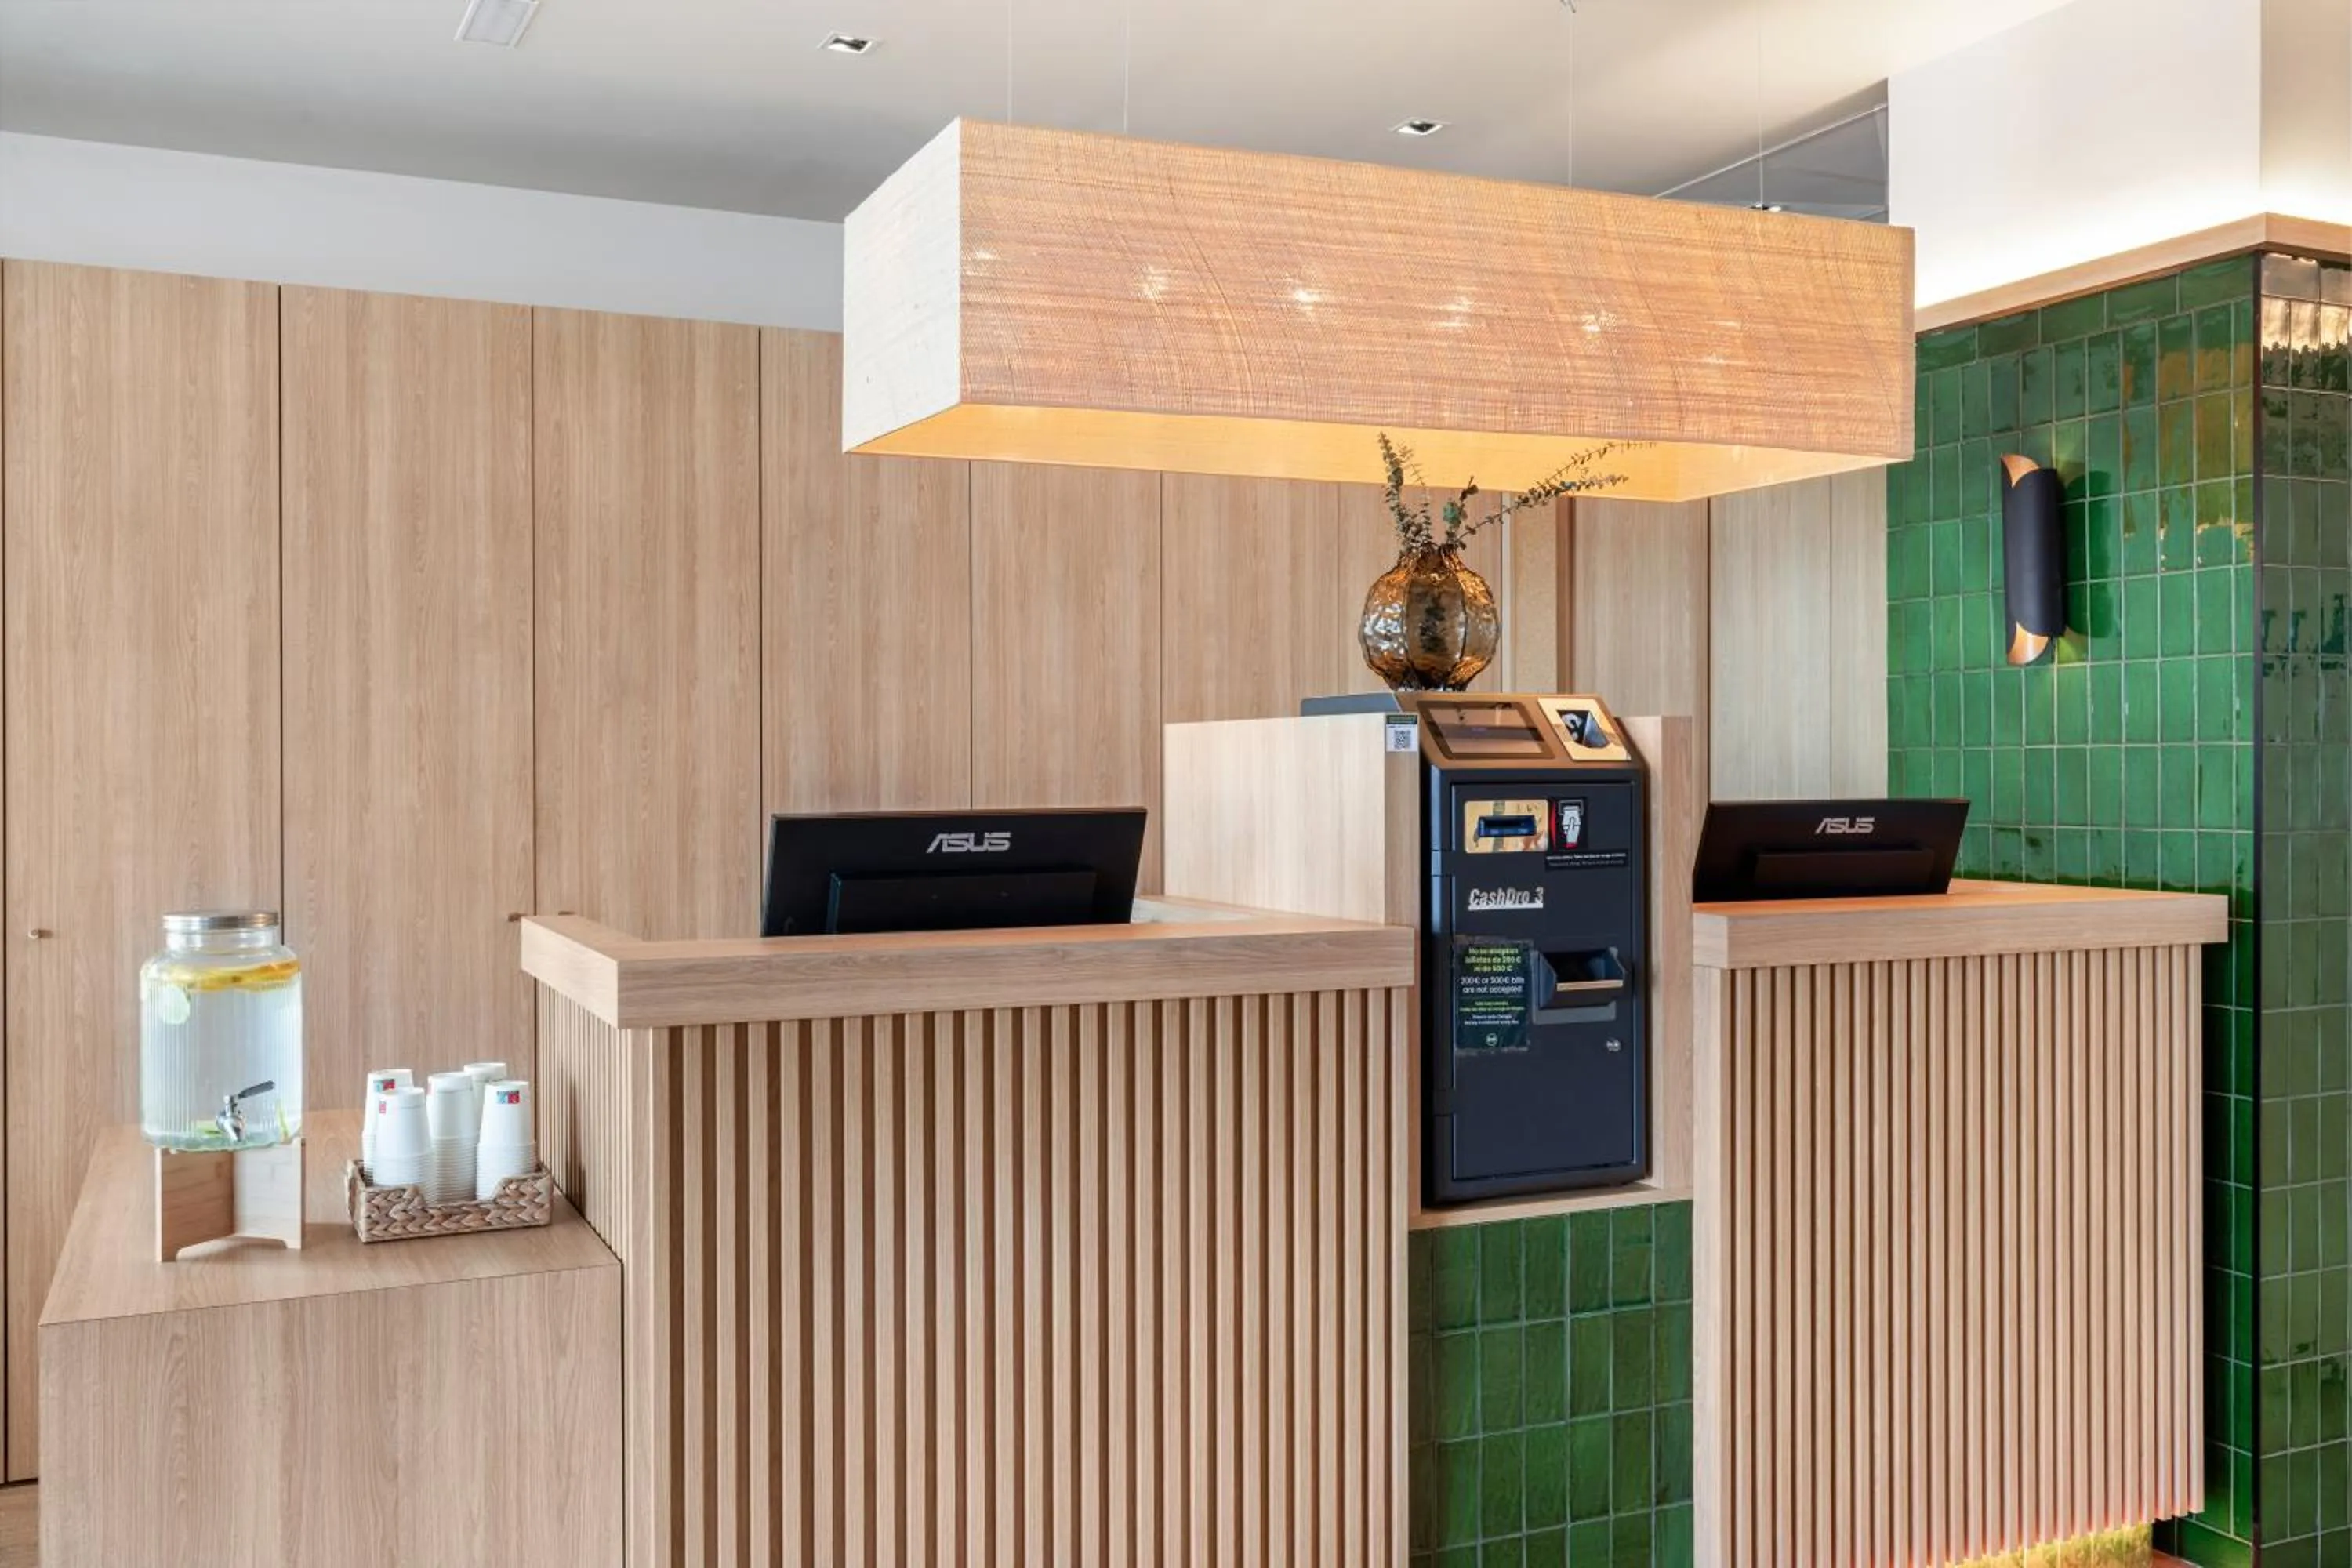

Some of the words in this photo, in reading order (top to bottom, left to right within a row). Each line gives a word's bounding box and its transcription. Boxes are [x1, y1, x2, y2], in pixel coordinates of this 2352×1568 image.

[1814, 817, 1875, 835] ASUS
[926, 832, 1011, 853] ASUS
[1469, 887, 1530, 906] CashDro
[1534, 887, 1544, 904] 3
